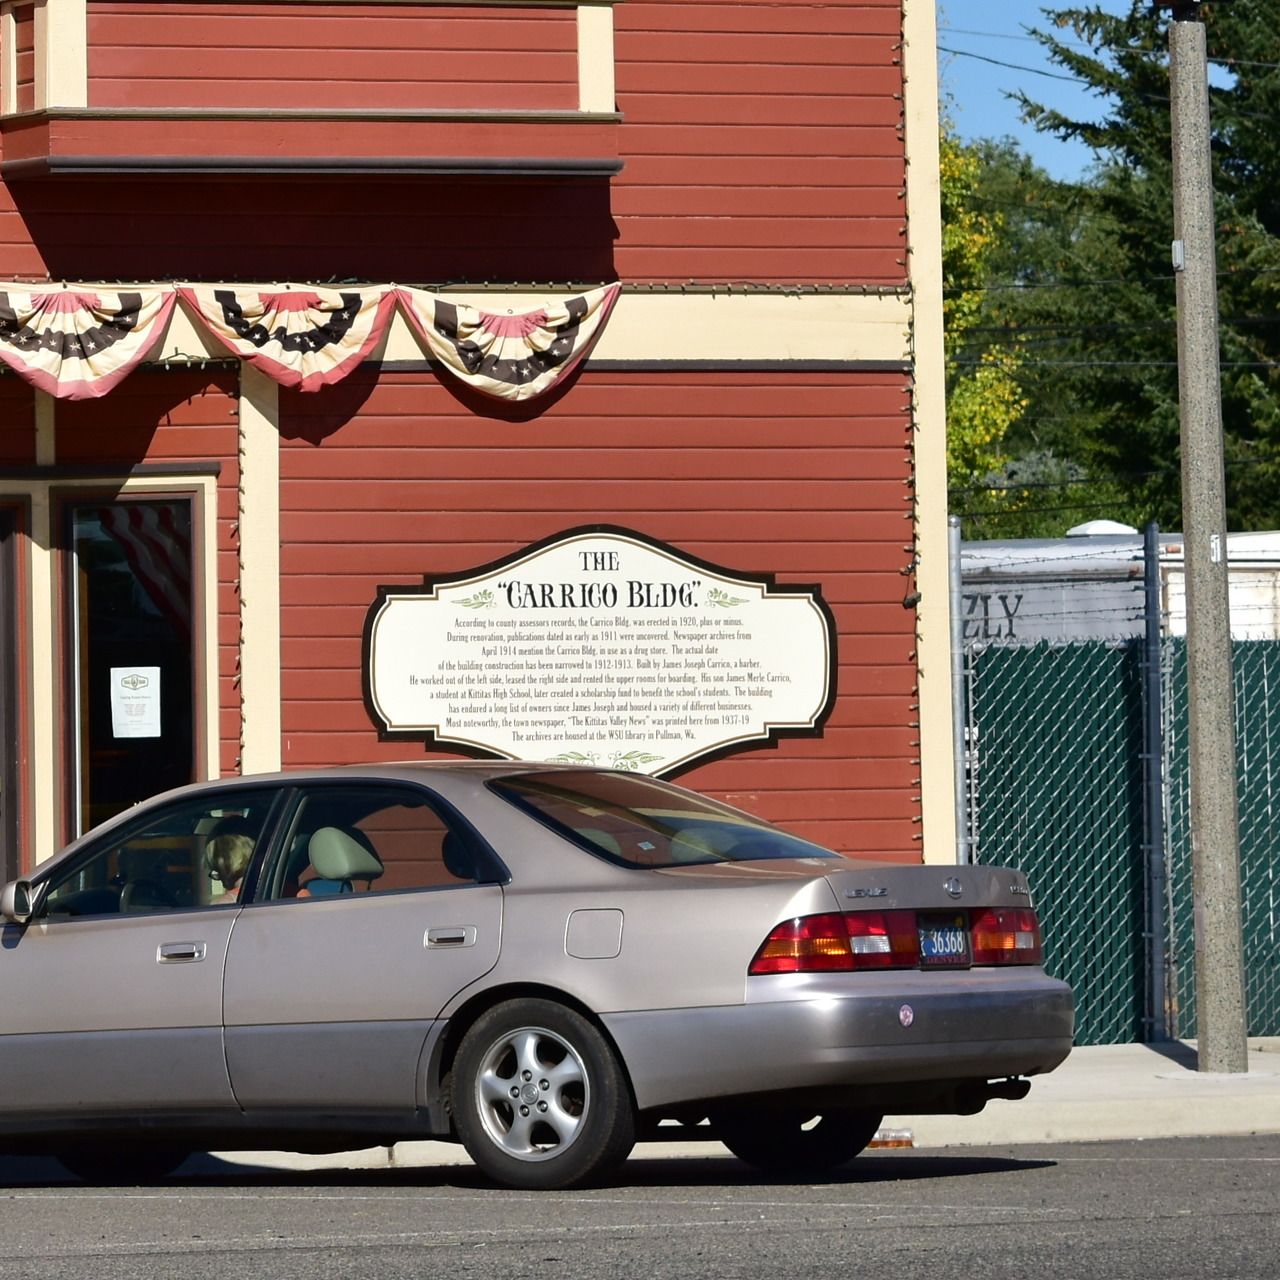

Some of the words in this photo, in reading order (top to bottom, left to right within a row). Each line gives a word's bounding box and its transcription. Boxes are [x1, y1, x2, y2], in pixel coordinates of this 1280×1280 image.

[579, 551, 620, 572] THE
[455, 617, 486, 629] According
[496, 618, 516, 629] county
[578, 616, 588, 626] the
[590, 616, 613, 626] Carrico
[647, 616, 670, 626] erected
[700, 615, 712, 627] plus
[447, 631, 468, 643] During
[507, 631, 545, 642] publications
[547, 631, 564, 641] dated
[574, 630, 589, 642] early
[601, 630, 617, 640] 1911
[674, 629, 707, 641] Newspaper
[710, 629, 735, 639] archives
[737, 629, 751, 639] from
[482, 645, 497, 658] April
[500, 645, 516, 656] 1914
[518, 645, 543, 656] mention
[545, 645, 555, 656] the
[557, 644, 580, 655] Carrico
[607, 647, 618, 655] use
[634, 644, 648, 656] drug
[673, 644, 683, 655] The
[685, 643, 703, 654] actual
[705, 643, 718, 654] date
[438, 661, 444, 671] of
[446, 661, 456, 671] the
[485, 660, 524, 670] construction
[526, 660, 536, 670] has
[538, 660, 553, 670] been
[555, 659, 584, 669] narrowed
[653, 659, 660, 670] by
[663, 659, 682, 669] James
[685, 658, 705, 670] Joseph
[410, 675, 418, 685] He
[446, 676, 455, 685] out
[458, 674, 463, 684] of
[466, 674, 475, 684] the
[477, 674, 487, 684] left
[506, 674, 526, 684] leased
[528, 674, 537, 684] the
[539, 674, 554, 685] right
[556, 674, 568, 684] side
[570, 673, 582, 683] and
[583, 673, 603, 683] rented
[605, 673, 614, 683] the
[658, 673, 666, 683] for
[701, 672, 711, 682] His
[727, 672, 745, 682] James
[747, 672, 764, 682] Merle
[435, 689, 458, 699] student
[468, 688, 491, 698] Kittitas
[493, 688, 507, 700] High
[510, 688, 532, 699] School,
[534, 688, 548, 698] later
[550, 688, 573, 698] created
[581, 687, 616, 699] scholarship
[618, 687, 632, 697] fund
[664, 687, 674, 697] the
[736, 686, 746, 696] The
[449, 703, 459, 713] has
[494, 702, 507, 714] long
[510, 702, 519, 712] list
[521, 702, 527, 712] of
[554, 702, 569, 712] since
[573, 701, 591, 711] James
[594, 701, 614, 713] Joseph
[616, 701, 628, 711] and
[630, 701, 652, 711] housed
[660, 701, 680, 712] variety
[682, 700, 688, 710] of
[690, 700, 716, 710] different
[446, 717, 461, 728] Most
[502, 716, 512, 727] the
[514, 717, 529, 727] town
[585, 715, 607, 726] Kittitas
[610, 715, 627, 728] Valley
[652, 718, 663, 726] was
[665, 715, 687, 727] printed
[689, 714, 702, 725] here
[705, 714, 719, 725] from
[513, 731, 523, 741] The
[526, 731, 551, 741] archives
[565, 730, 587, 740] housed
[596, 730, 606, 740] the
[609, 730, 623, 740] WSU
[625, 730, 646, 742] library
